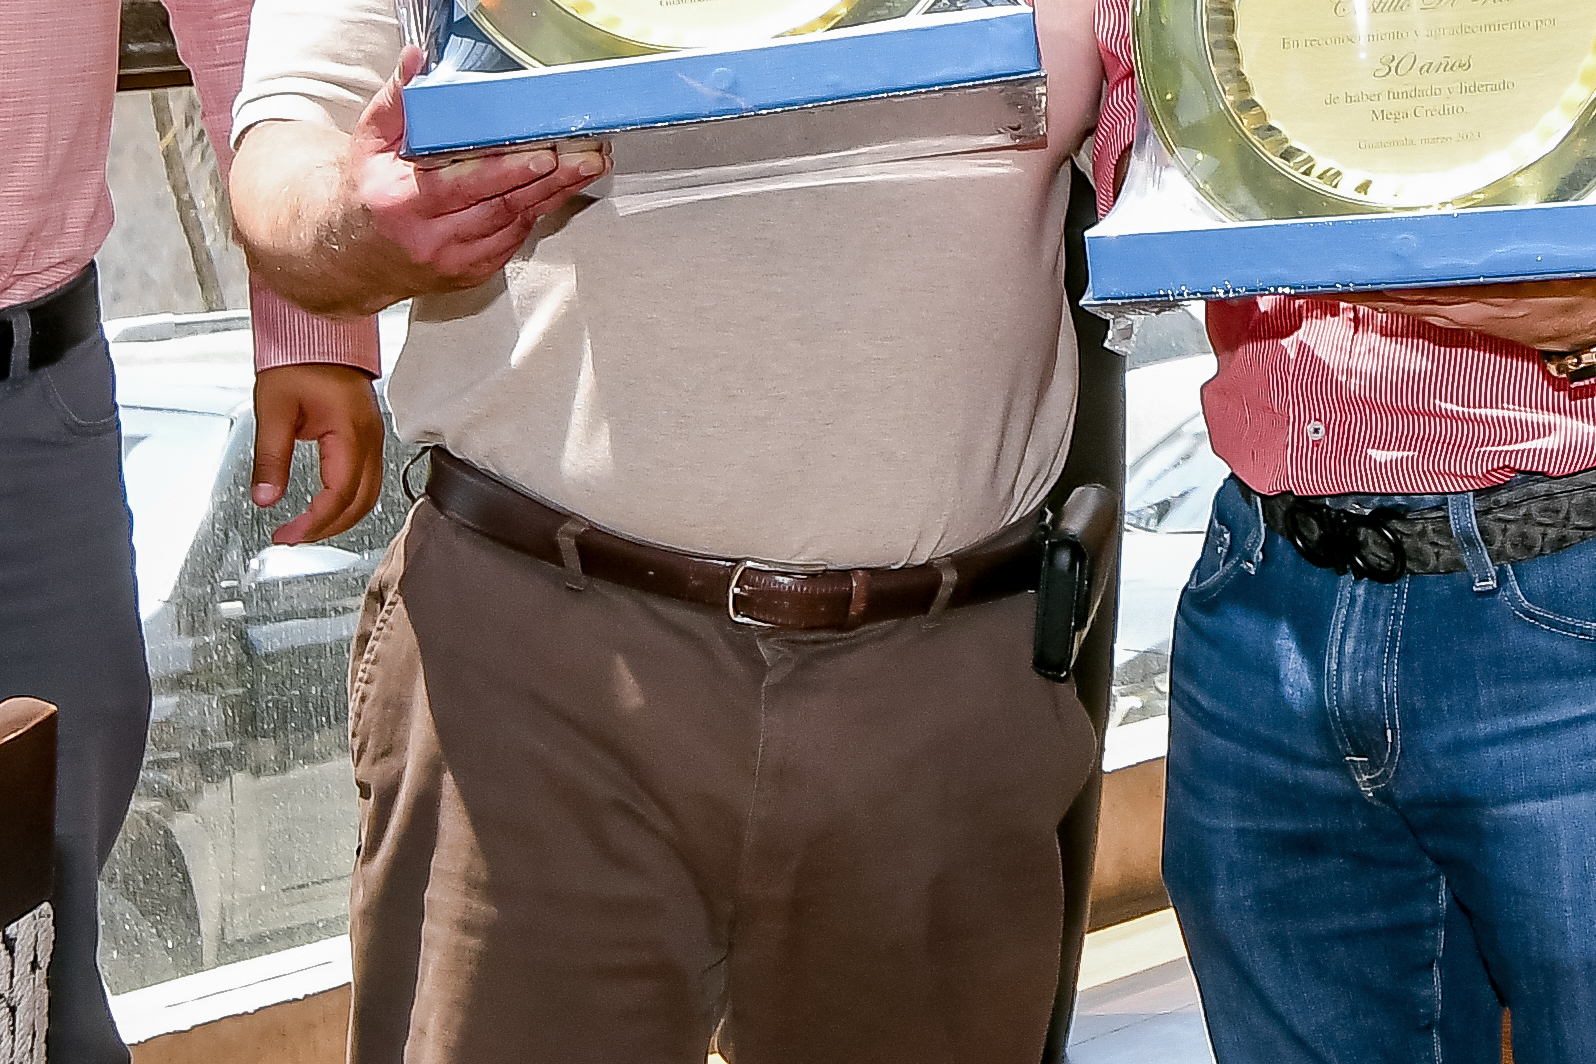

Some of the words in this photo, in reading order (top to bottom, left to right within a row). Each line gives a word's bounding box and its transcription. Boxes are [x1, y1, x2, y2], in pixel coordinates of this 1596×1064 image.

[1281, 37, 1300, 50] En
[1412, 28, 1420, 41] y
[1425, 17, 1531, 41] agradecimiento
[1534, 17, 1557, 32] por
[1373, 51, 1417, 78] 30
[1419, 54, 1473, 76] años
[1324, 93, 1340, 106] de
[1344, 88, 1383, 104] haber
[1387, 83, 1442, 101] fundado
[1446, 86, 1454, 99] y
[1458, 79, 1516, 95] liderado
[1369, 107, 1410, 123] Mega
